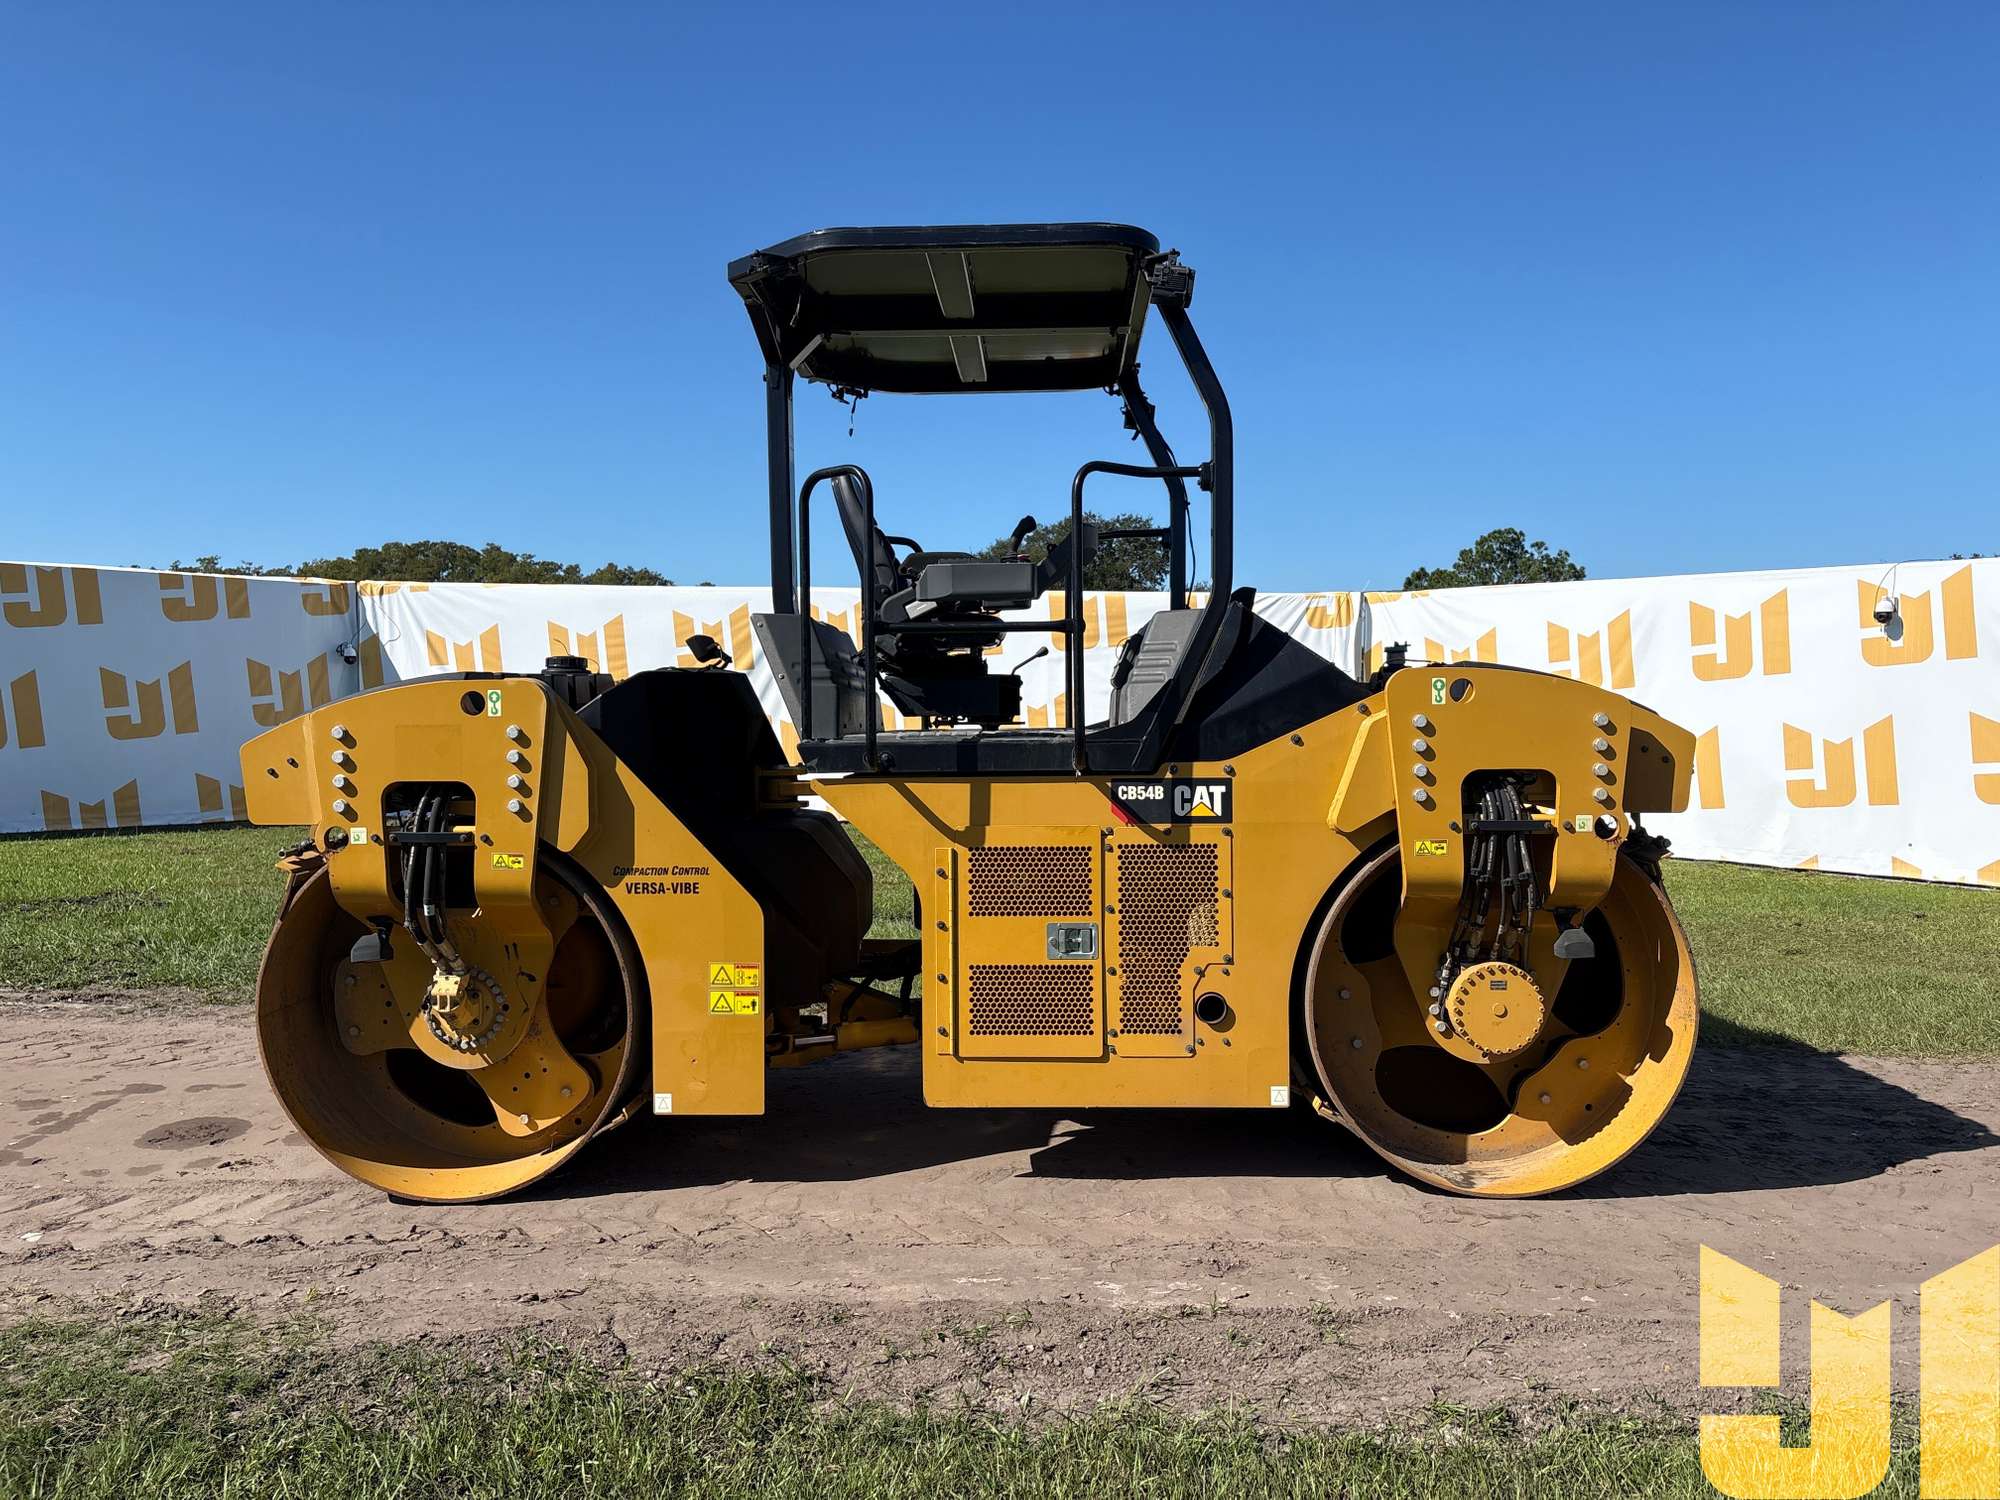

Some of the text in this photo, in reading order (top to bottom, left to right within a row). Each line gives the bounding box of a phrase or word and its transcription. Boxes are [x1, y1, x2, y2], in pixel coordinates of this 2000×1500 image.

[1118, 785, 1164, 800] CB54B
[1174, 785, 1226, 816] CAT
[626, 882, 699, 895] VERSA-VIBE
